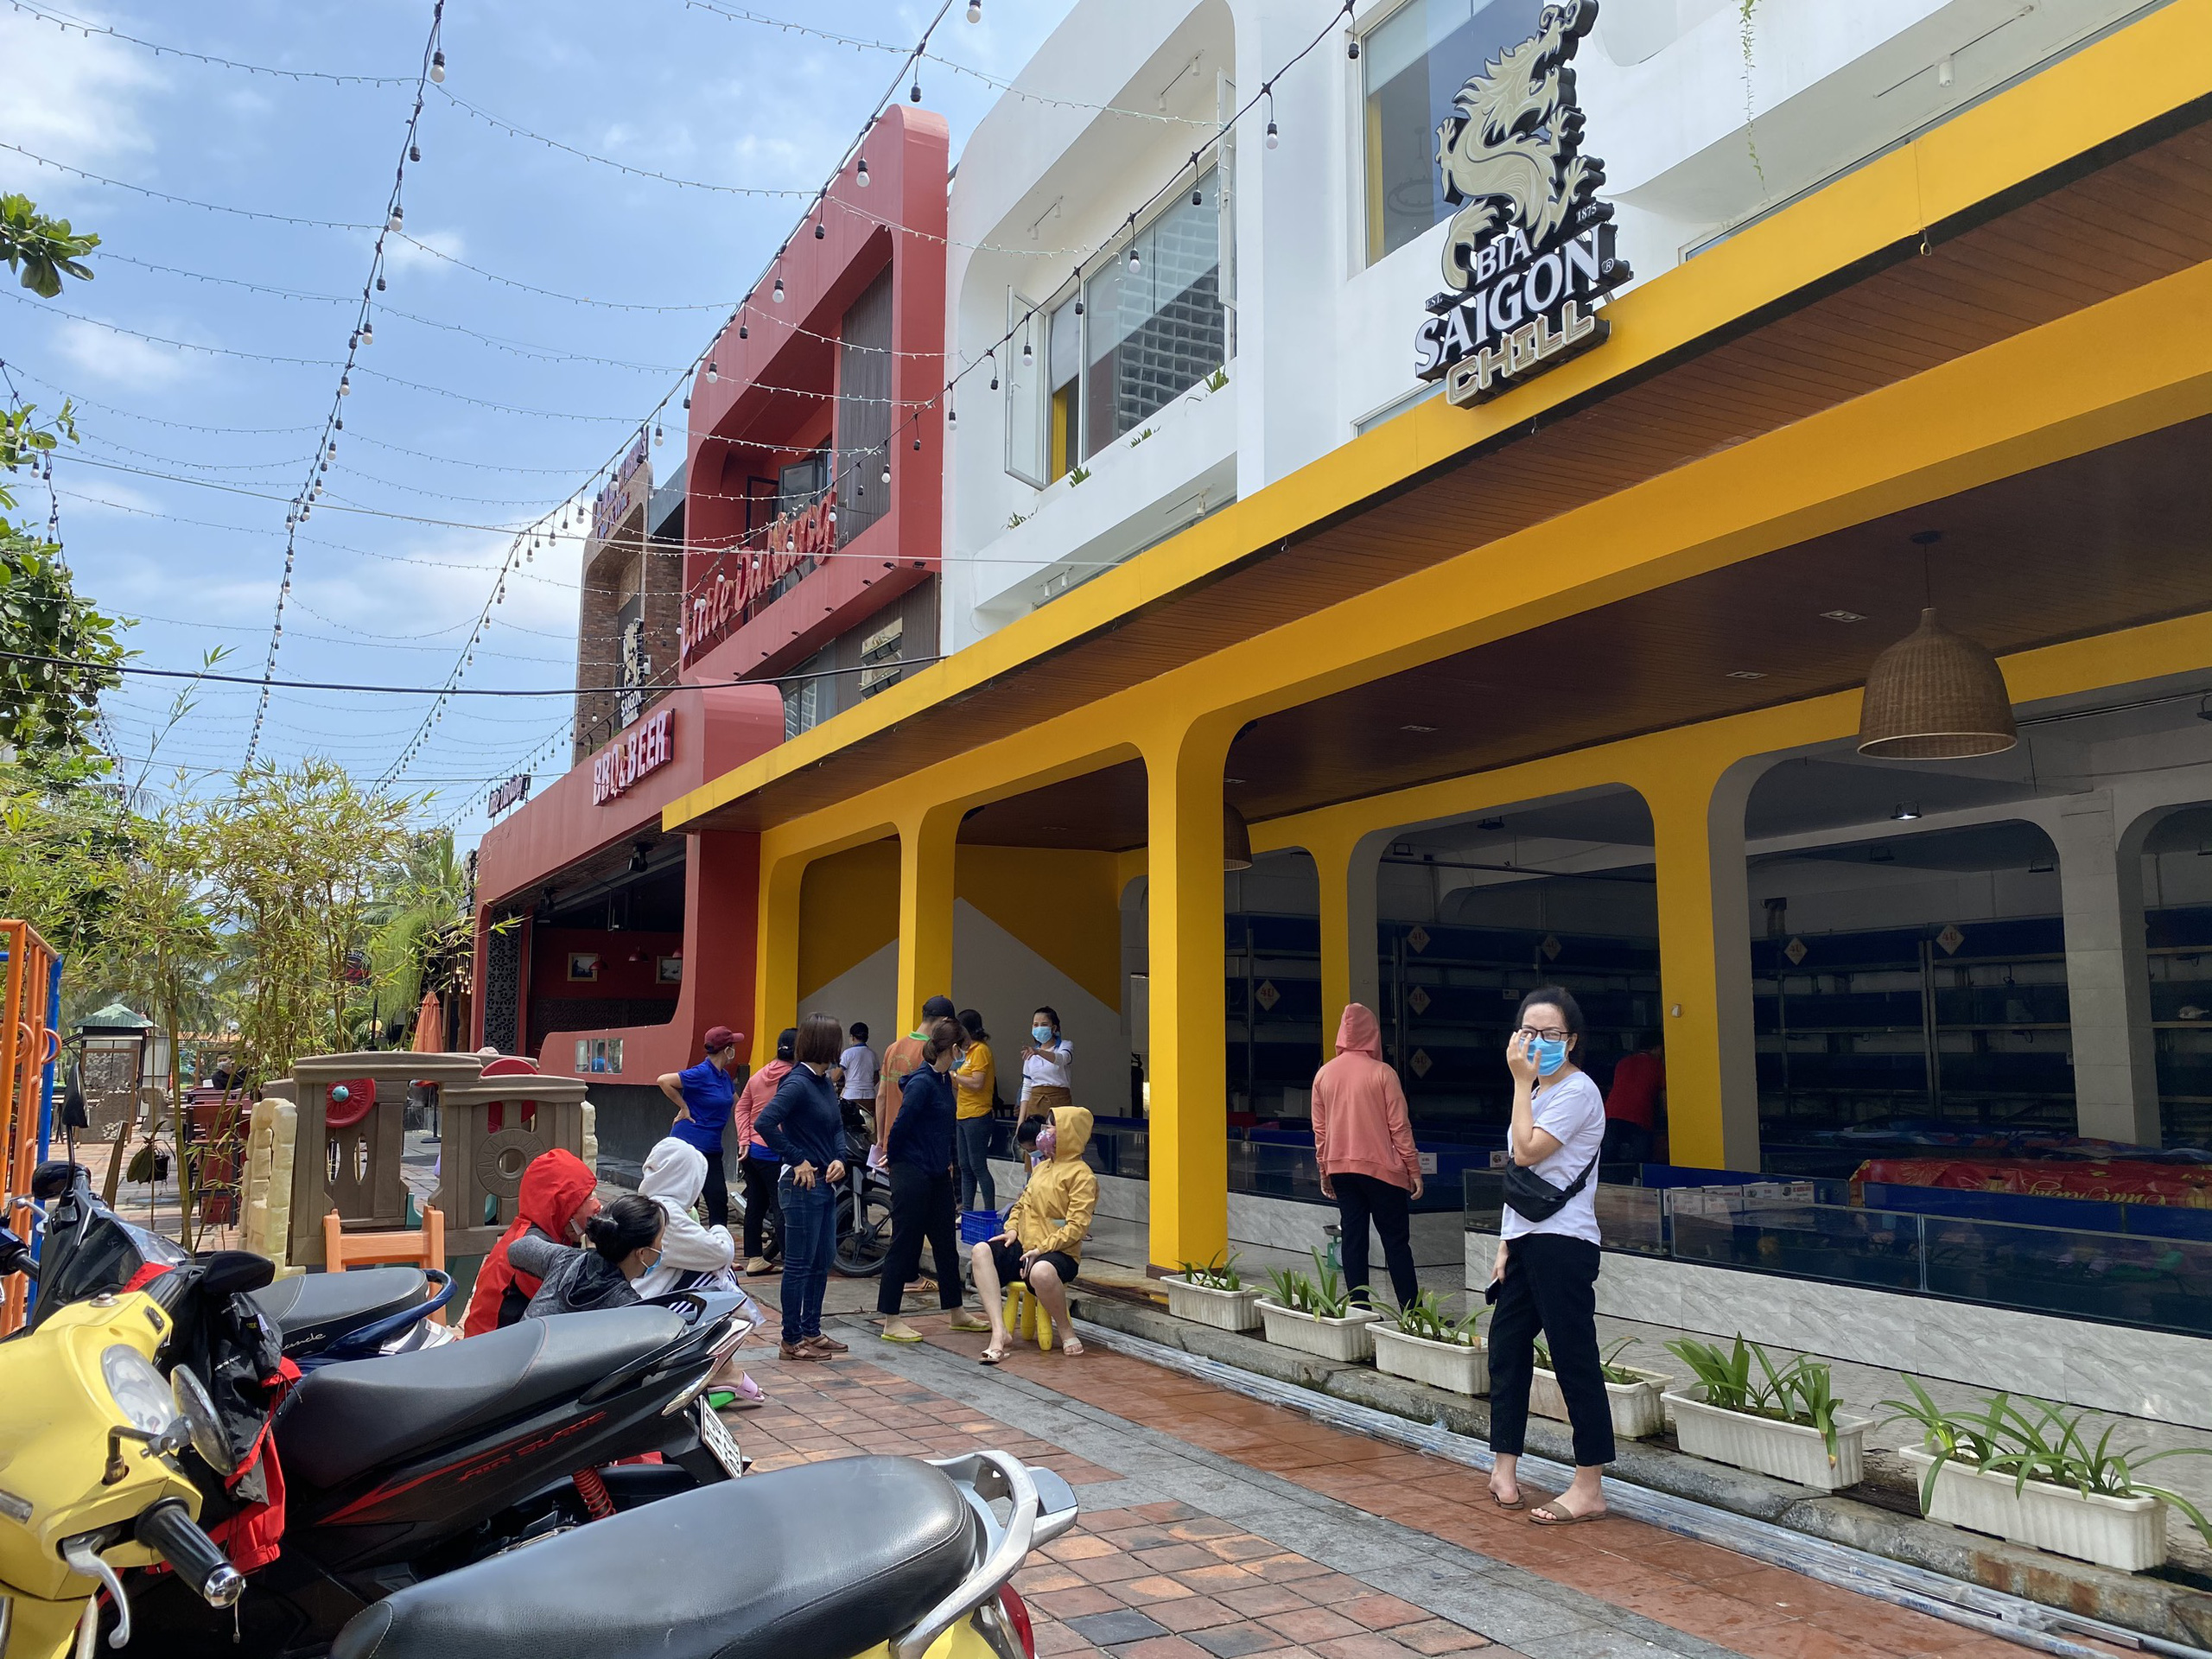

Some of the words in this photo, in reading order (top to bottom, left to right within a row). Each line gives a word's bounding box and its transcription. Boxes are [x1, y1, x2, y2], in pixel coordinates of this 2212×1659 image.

[1575, 203, 1598, 225] 1875
[1475, 229, 1533, 286] BIA
[1446, 300, 1596, 406] CHILL
[1942, 931, 1957, 941] 4U
